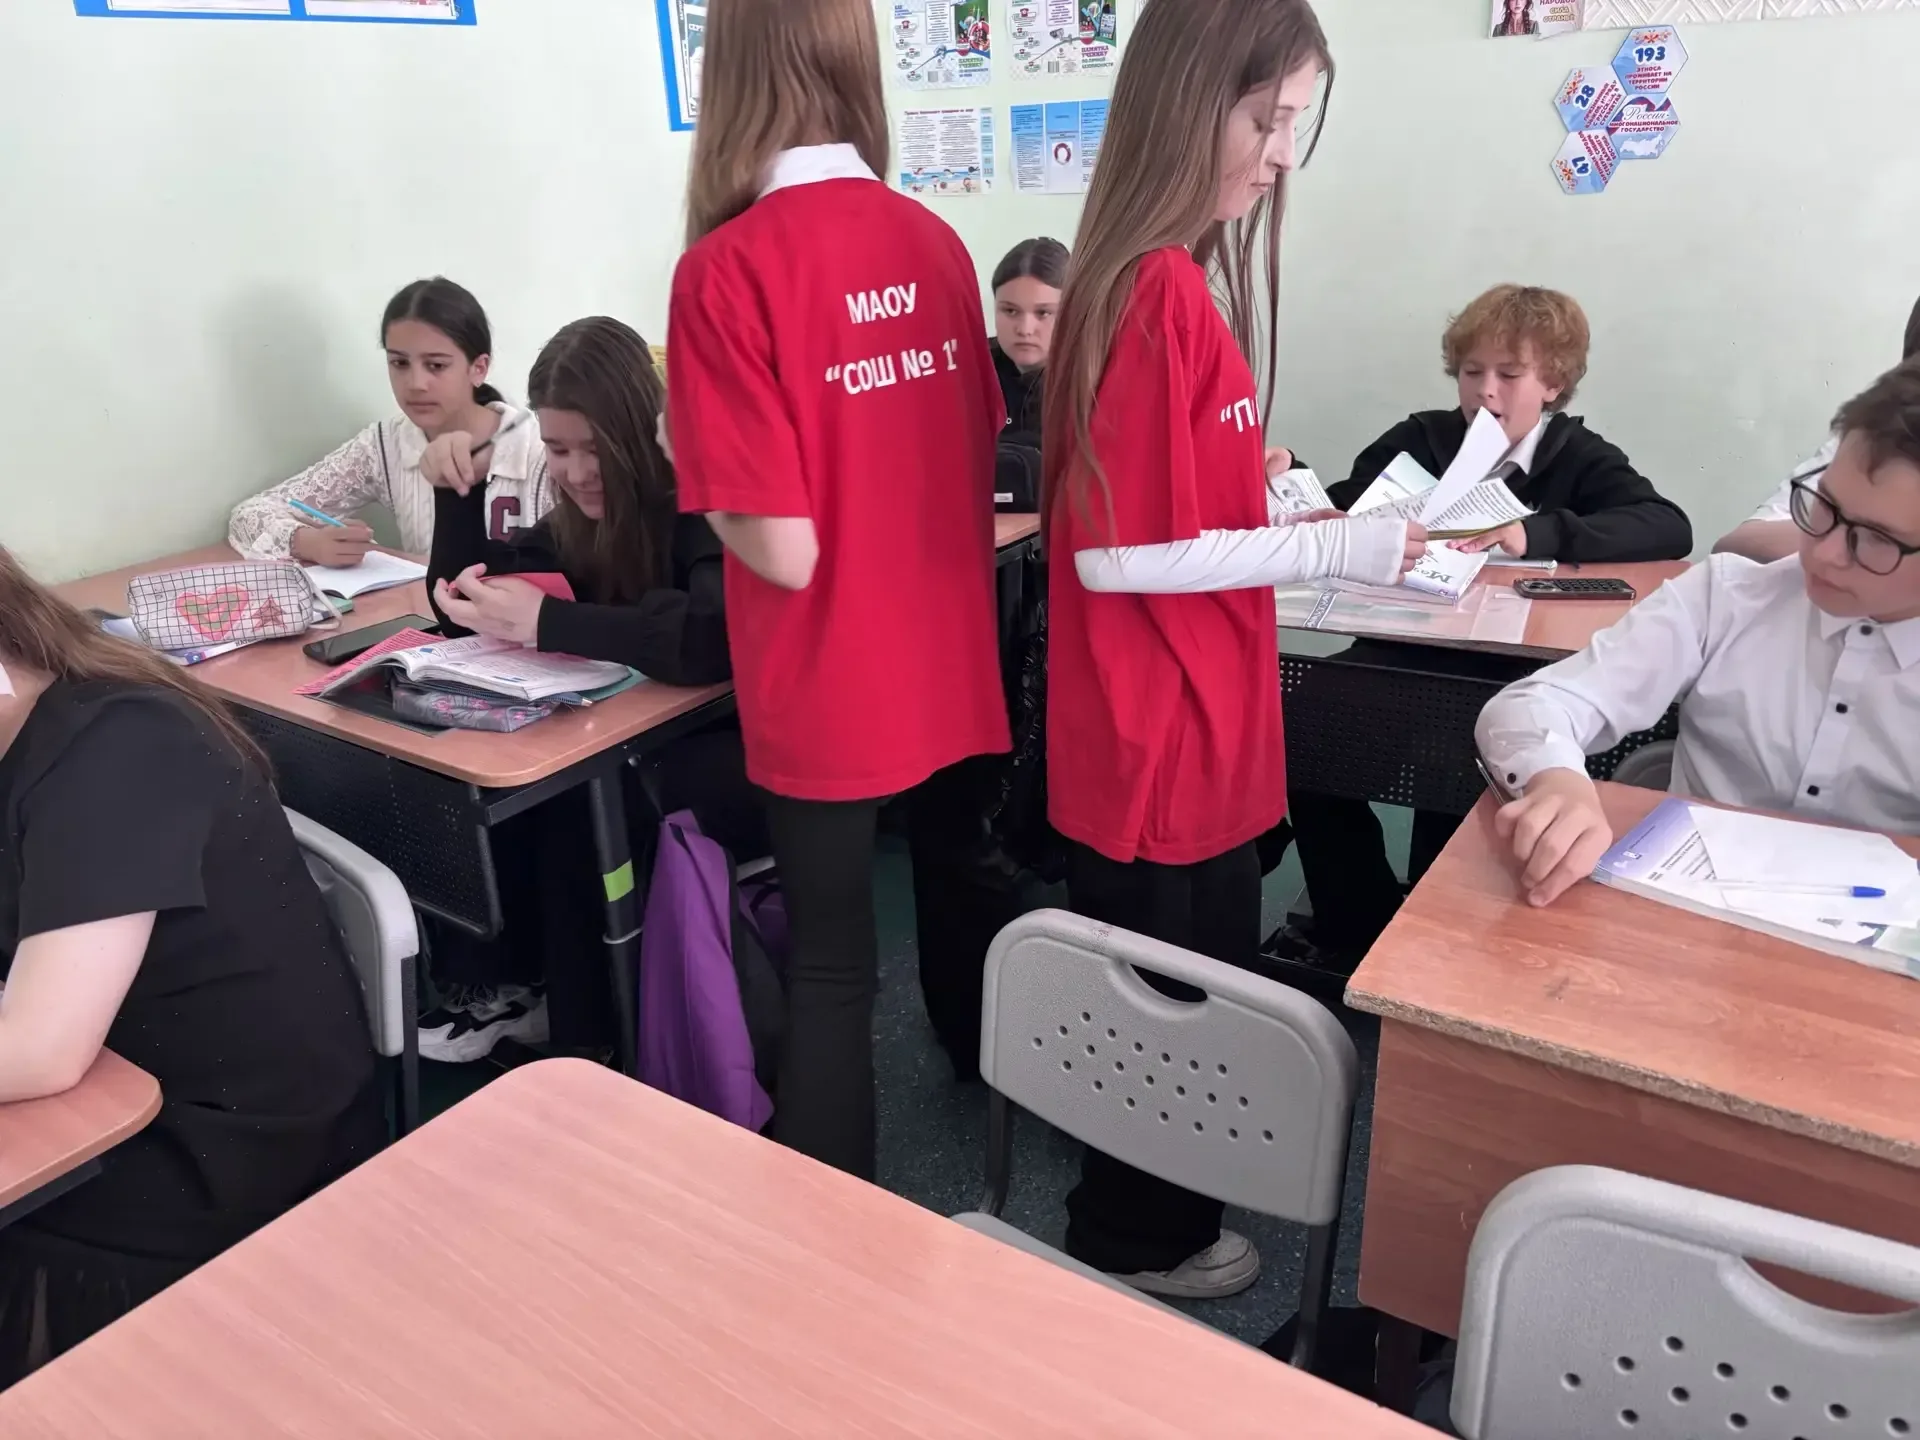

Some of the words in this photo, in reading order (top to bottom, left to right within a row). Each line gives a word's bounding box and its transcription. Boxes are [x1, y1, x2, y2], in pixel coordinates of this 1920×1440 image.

[1635, 46, 1666, 63] 193
[1629, 77, 1668, 85] ТЕРРИТОРИИ
[1575, 84, 1596, 108] 28
[1571, 156, 1589, 174] 47
[845, 282, 917, 324] МАОУ
[900, 348, 936, 381] №
